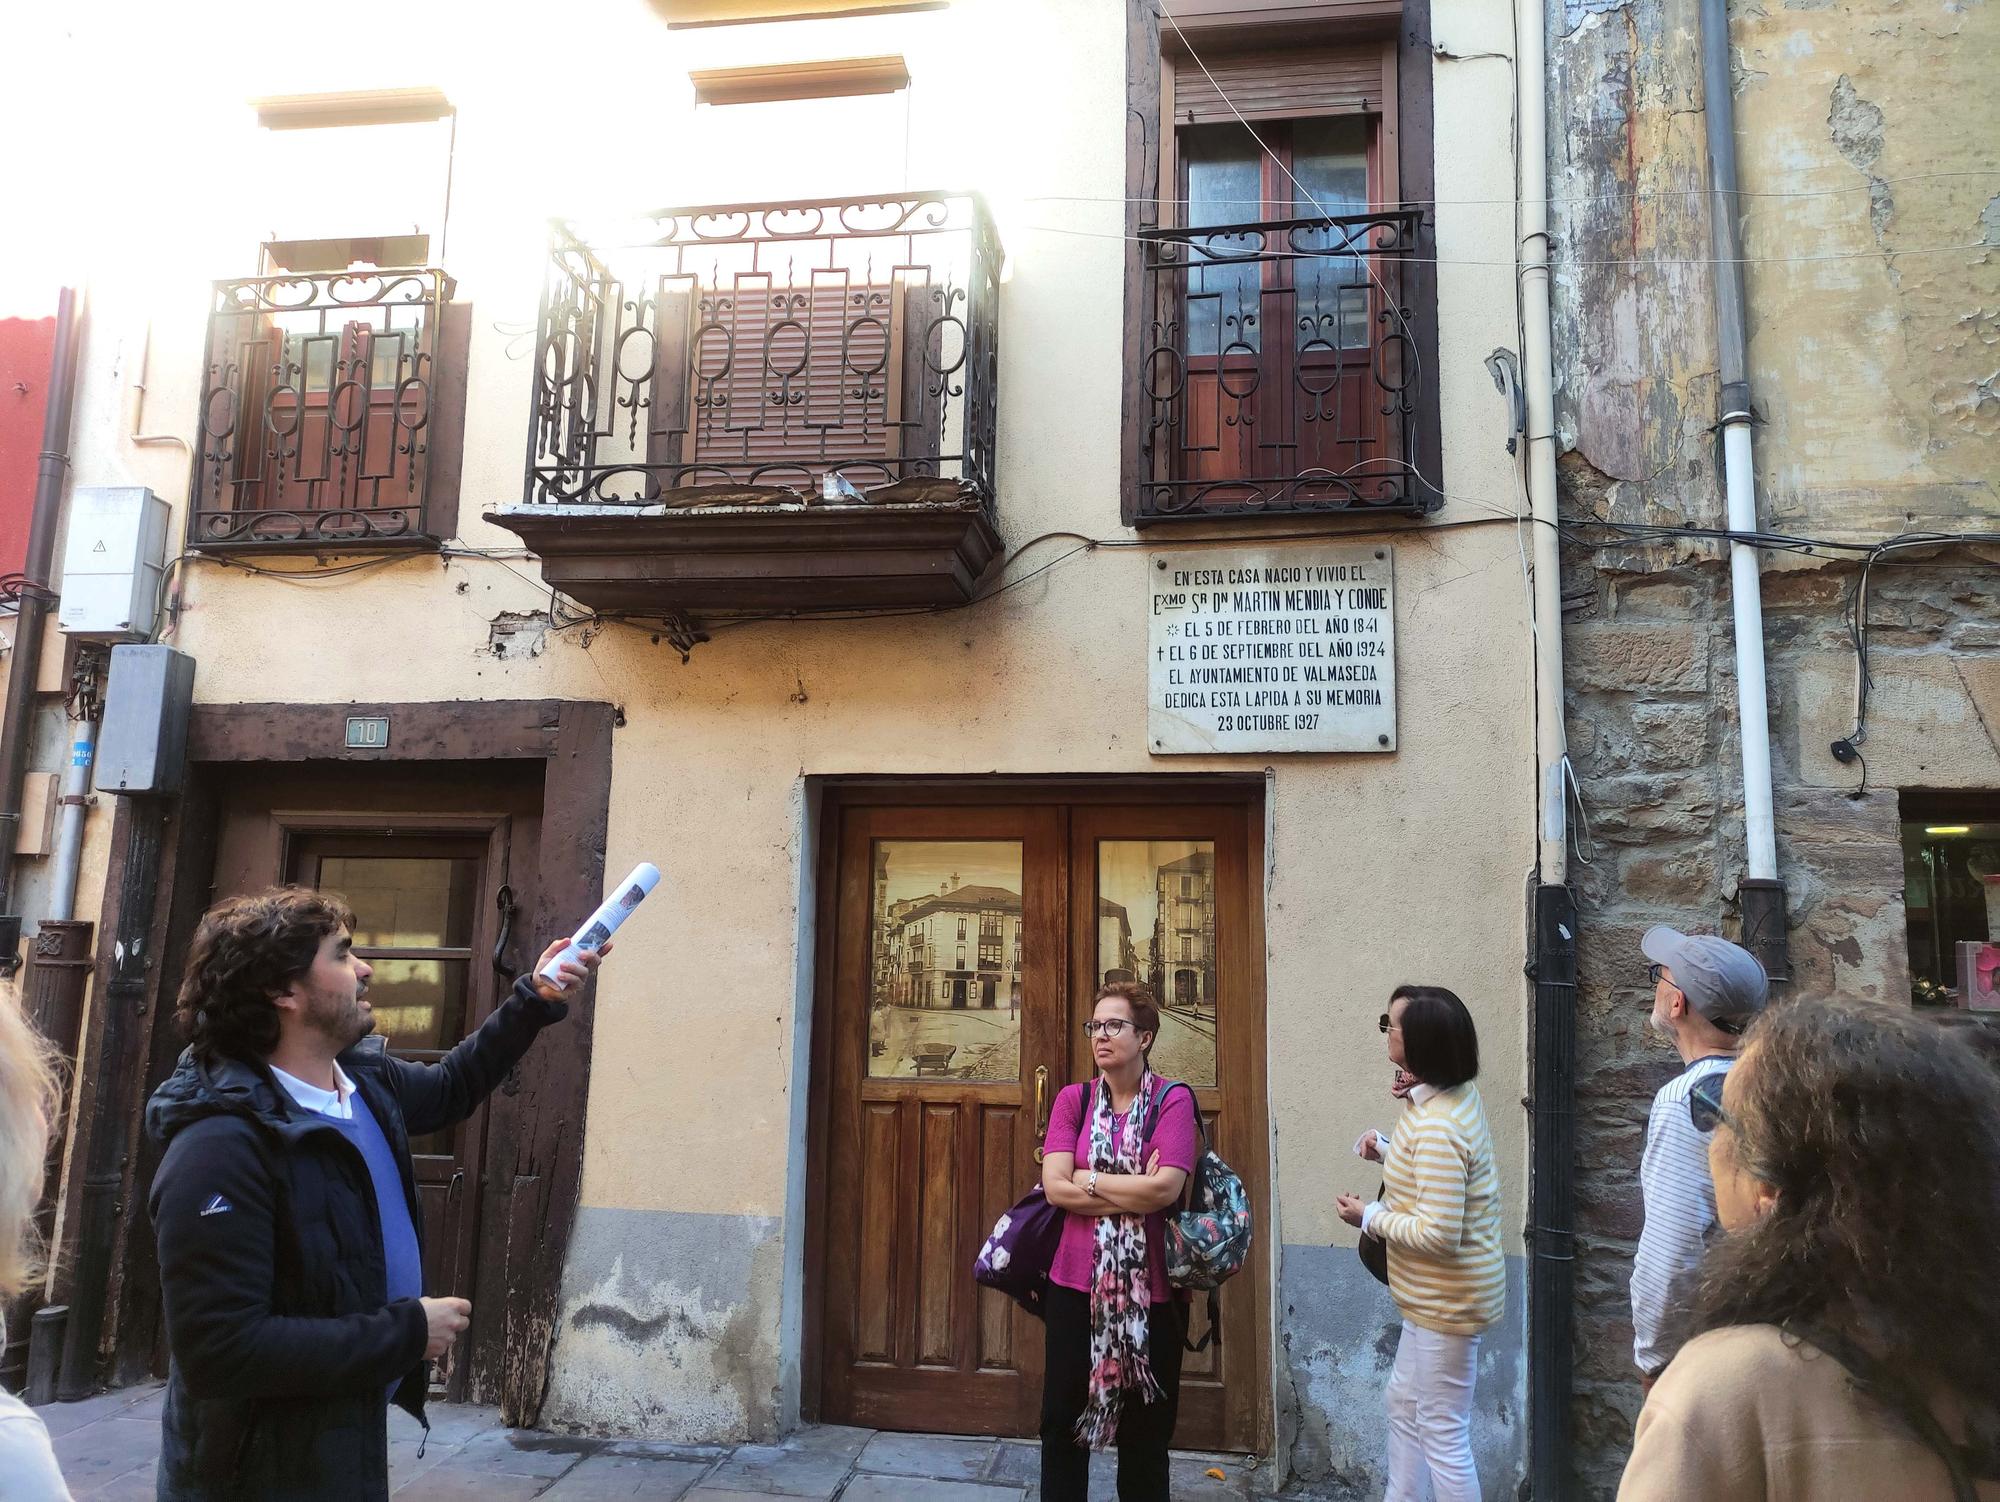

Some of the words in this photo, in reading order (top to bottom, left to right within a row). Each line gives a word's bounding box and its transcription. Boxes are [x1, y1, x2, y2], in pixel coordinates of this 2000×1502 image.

[1174, 571, 1190, 586] EN
[1194, 570, 1224, 585] ESTA
[1228, 568, 1260, 584] CASA
[1265, 567, 1301, 583] NACIO
[1304, 566, 1313, 582] Y
[1316, 566, 1347, 582] VIVIO
[1351, 565, 1366, 581] EL
[1233, 590, 1280, 613] MARTIN
[1285, 589, 1331, 611] MENDIA
[1334, 588, 1344, 610] Y
[1348, 588, 1387, 610] CONDE
[1185, 622, 1200, 637] EL
[1205, 621, 1213, 636] 5
[1217, 620, 1233, 636] DE
[1238, 619, 1291, 636] FEBRERO
[1296, 618, 1320, 634] DEL
[1325, 614, 1349, 634] AÑO
[1353, 617, 1378, 633] 1841
[1169, 645, 1185, 661] EL
[1189, 645, 1197, 660] 6
[1202, 644, 1219, 660] DE
[1222, 642, 1294, 660] SEPTIEMBRE
[1299, 642, 1324, 658] DEL
[1328, 638, 1353, 658] AÑO
[1357, 641, 1385, 657] 1924
[1169, 669, 1185, 684] EL
[1189, 666, 1278, 684] AYUNTAMIENTO
[1283, 666, 1298, 682] DE
[1304, 665, 1377, 682] VALMASEDA
[1165, 692, 1206, 708] DEDICA
[1211, 691, 1241, 707] ESTA
[1245, 690, 1289, 707] LAPIDA
[1294, 690, 1301, 706] A
[1306, 690, 1322, 706] SU
[1327, 689, 1381, 706] MEMORIA
[358, 722, 378, 743] 10
[1217, 715, 1233, 731] 23
[1237, 714, 1290, 731] OCTUBRE
[1294, 714, 1320, 730] 1927
